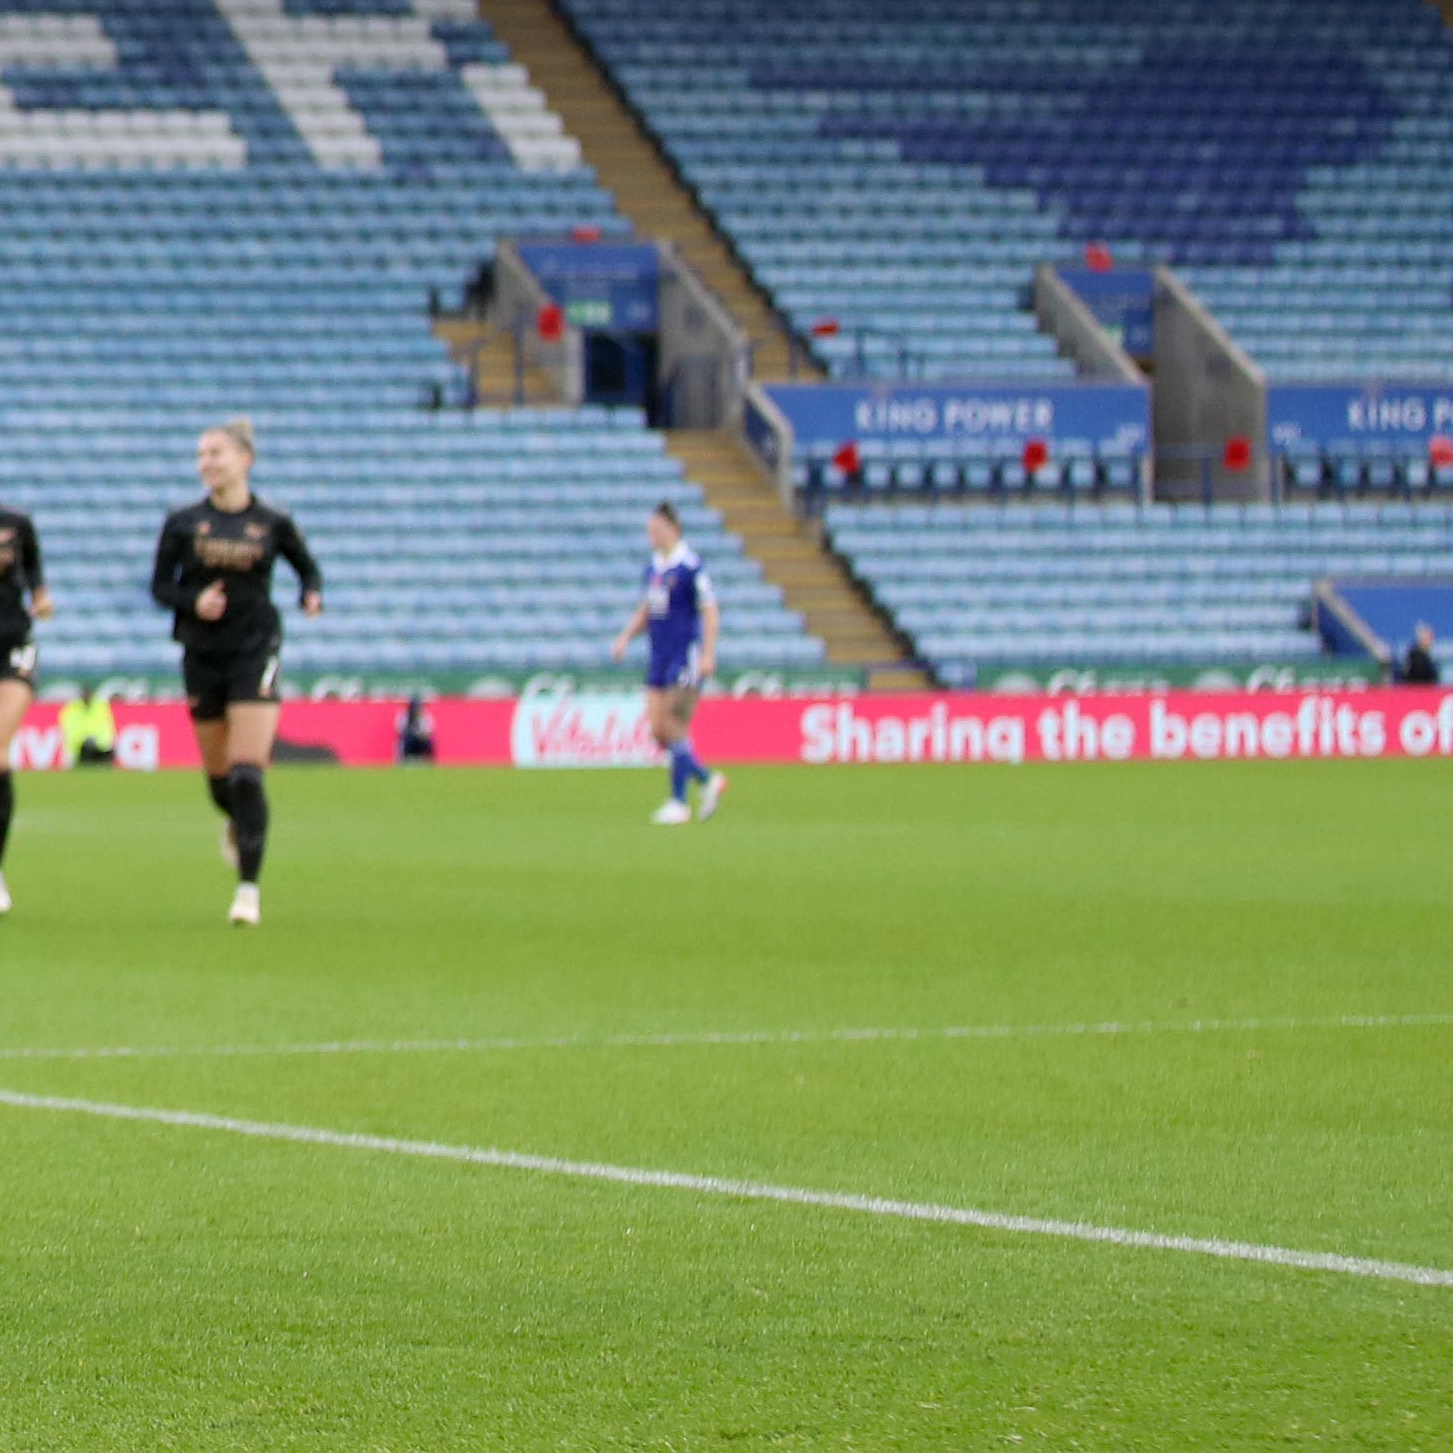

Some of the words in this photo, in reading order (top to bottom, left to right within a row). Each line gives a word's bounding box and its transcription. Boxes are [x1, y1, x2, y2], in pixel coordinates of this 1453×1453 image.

[854, 396, 938, 434] KING
[945, 397, 1054, 436] POWER
[1347, 396, 1427, 433] KING
[800, 700, 1026, 764] Sharing
[1037, 700, 1135, 762] the
[1149, 696, 1388, 760] benefits
